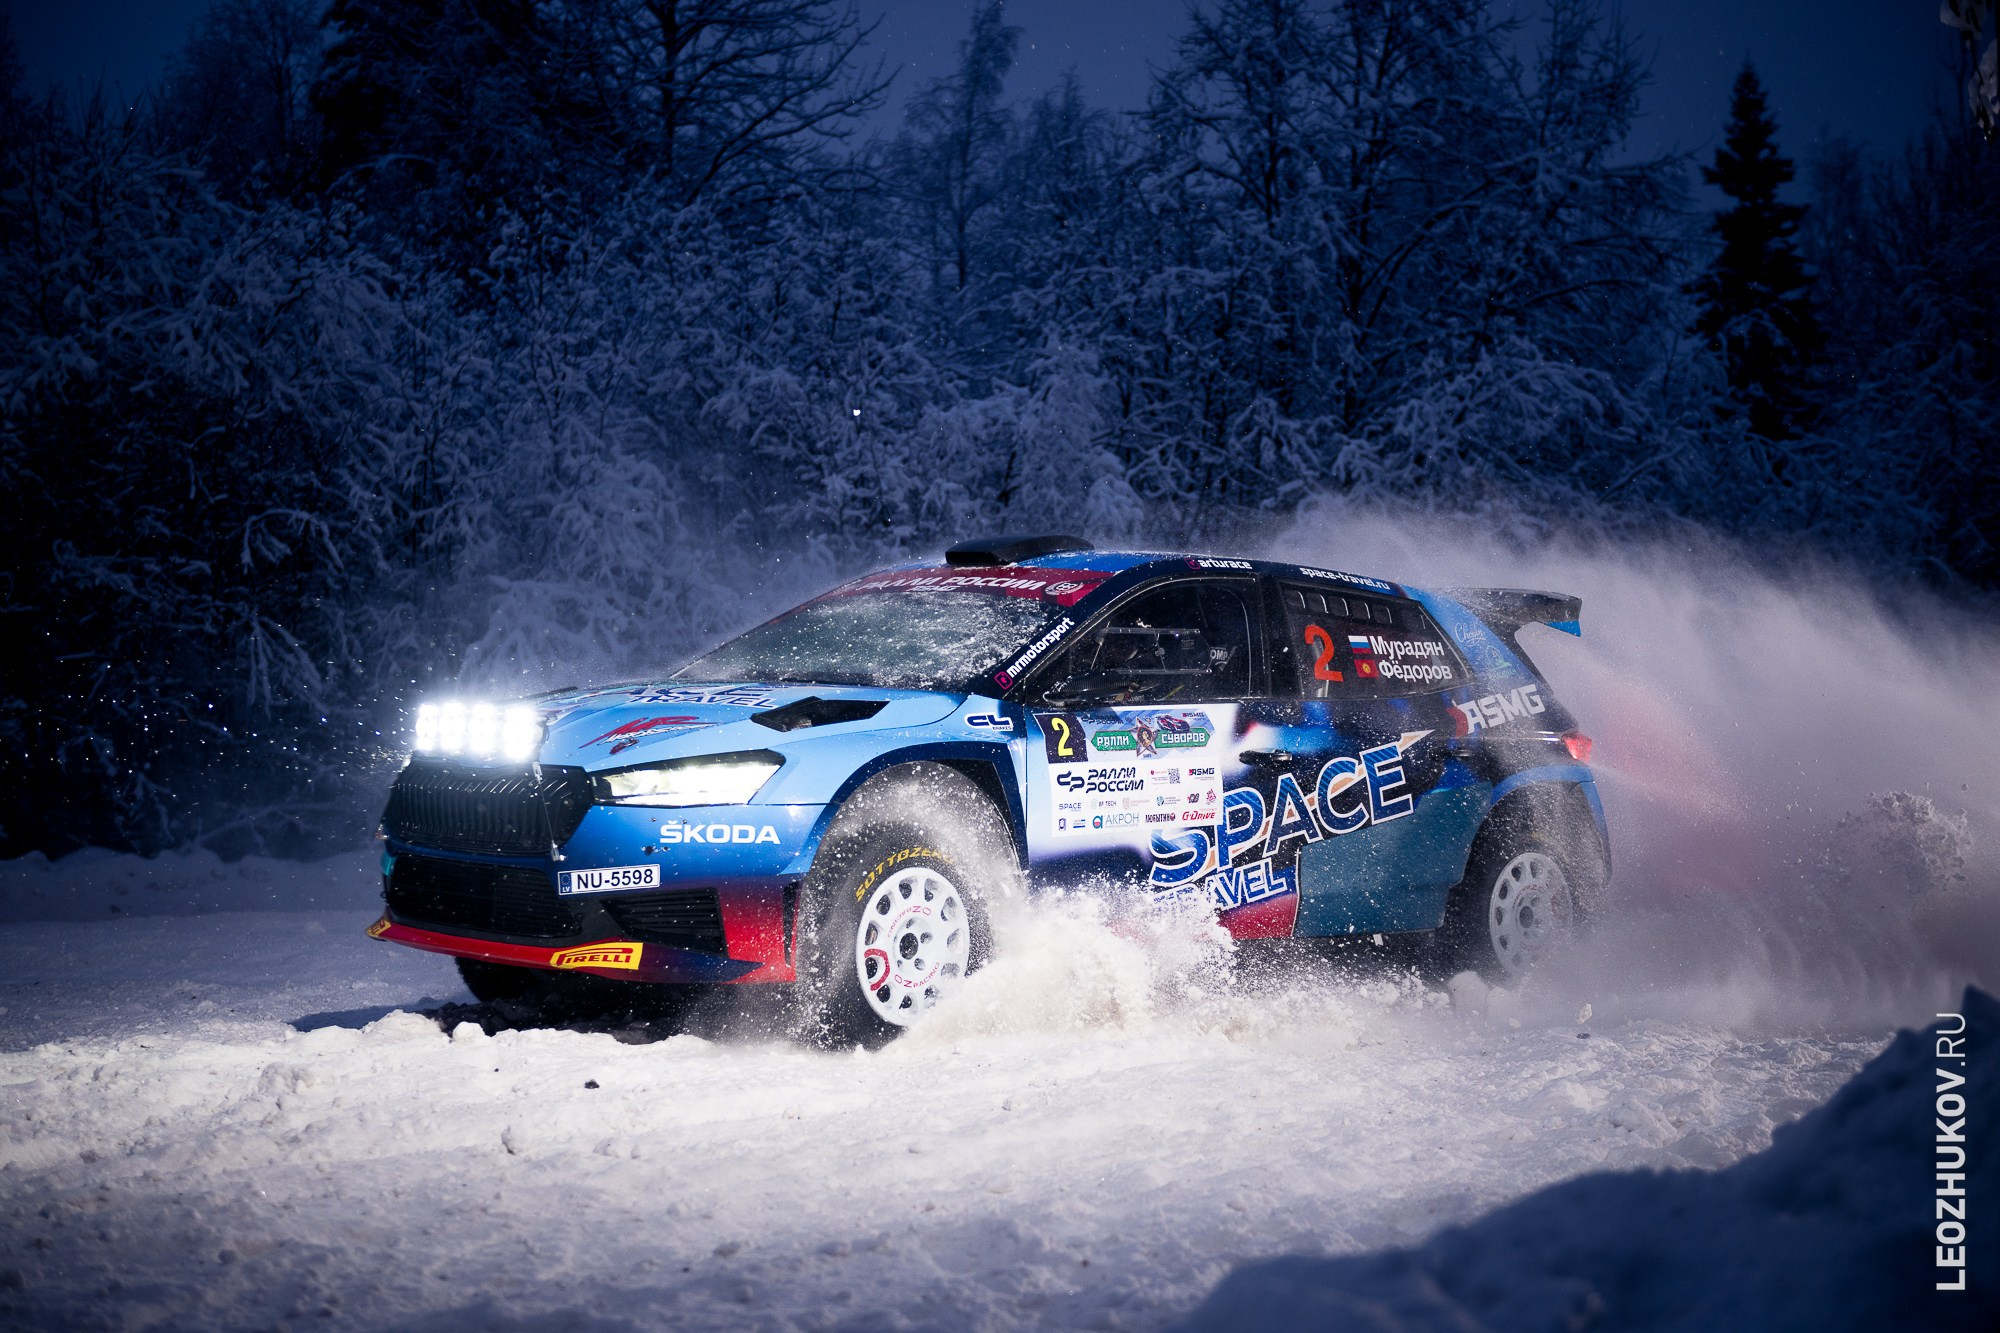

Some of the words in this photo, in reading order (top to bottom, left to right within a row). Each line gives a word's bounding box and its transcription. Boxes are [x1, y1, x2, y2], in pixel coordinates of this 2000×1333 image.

[1198, 558, 1253, 570] arturace
[940, 577, 1047, 591] РОССИИ
[1300, 566, 1391, 590] space-travel.ru
[1006, 616, 1076, 678] mrmotorsport
[1304, 624, 1345, 682] 2
[1369, 635, 1445, 660] Мурадян
[1378, 659, 1453, 684] Фёдоров
[629, 695, 776, 709] TRAVEL
[1450, 684, 1546, 735] ASMG
[967, 714, 1011, 727] CL
[1051, 717, 1074, 757] 2
[1096, 735, 1130, 747] РАЛЛИ
[1161, 732, 1206, 744] СУВОРОВ
[1087, 766, 1137, 781] РАЛЛИ
[1189, 767, 1215, 776] ASMG
[1085, 779, 1145, 794] РОССИИ
[1058, 802, 1082, 810] SPACE
[1148, 742, 1415, 887] SPACE
[1105, 813, 1140, 825] АКРОН
[659, 820, 781, 845] ŠKODA
[577, 868, 654, 890] NU-5598
[555, 947, 634, 967] PIRELLI
[912, 961, 940, 988] RACING
